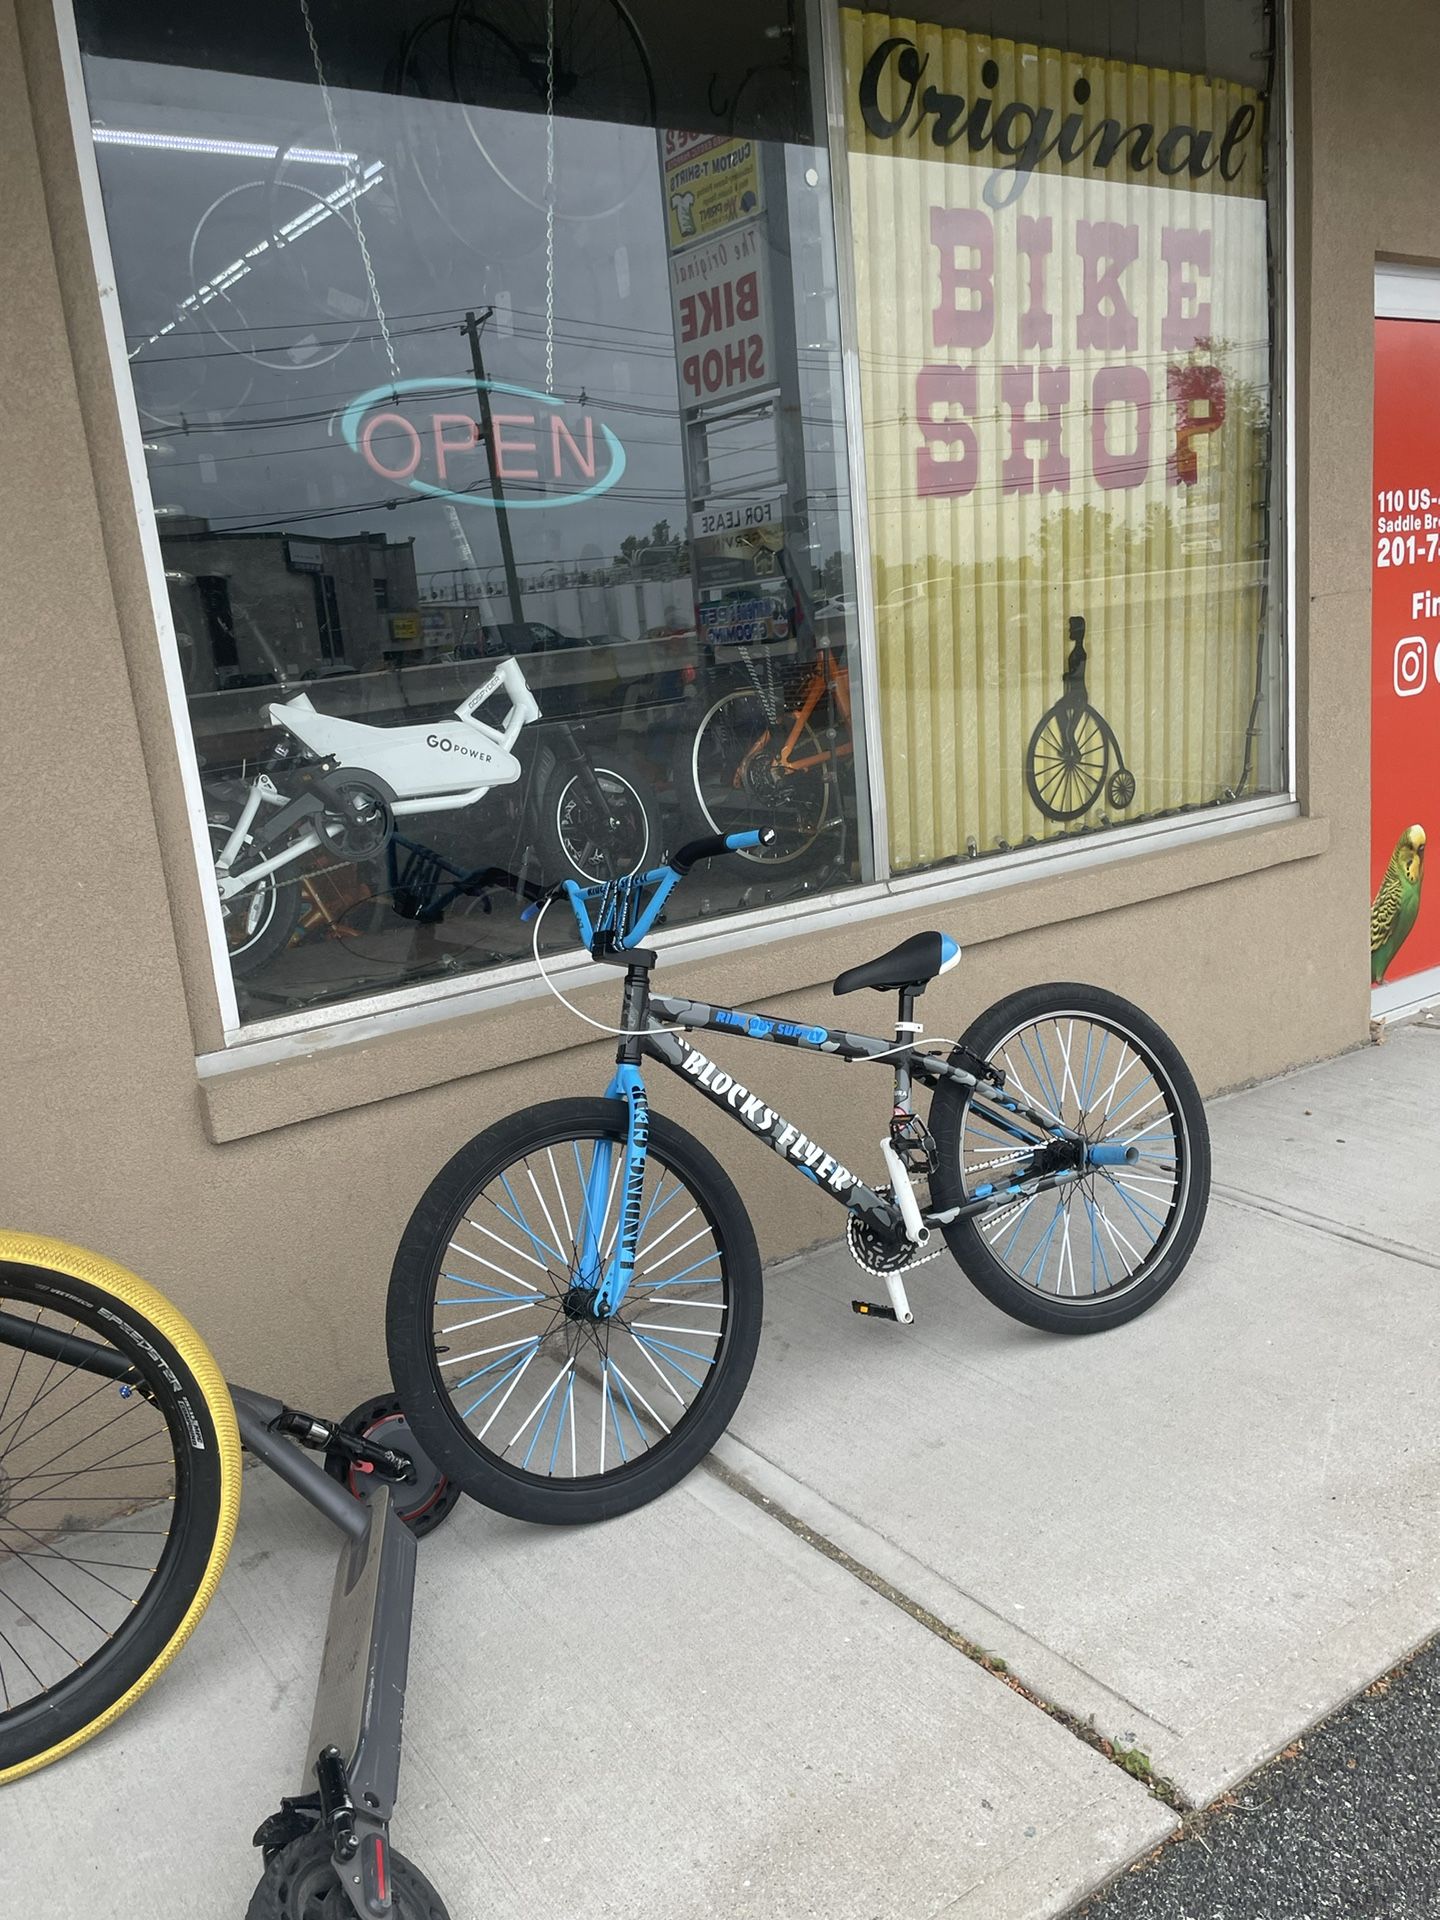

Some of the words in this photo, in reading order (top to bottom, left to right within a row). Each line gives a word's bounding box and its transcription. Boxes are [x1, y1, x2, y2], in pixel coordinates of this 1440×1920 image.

[860, 38, 1255, 210] Original
[930, 206, 1212, 352] BIKE
[360, 413, 597, 480] OPEN
[916, 364, 1226, 498] SHOP
[1377, 489, 1404, 513] 110
[1377, 516, 1422, 534] Saddle
[97, 1307, 183, 1393] SPEEDSTER
